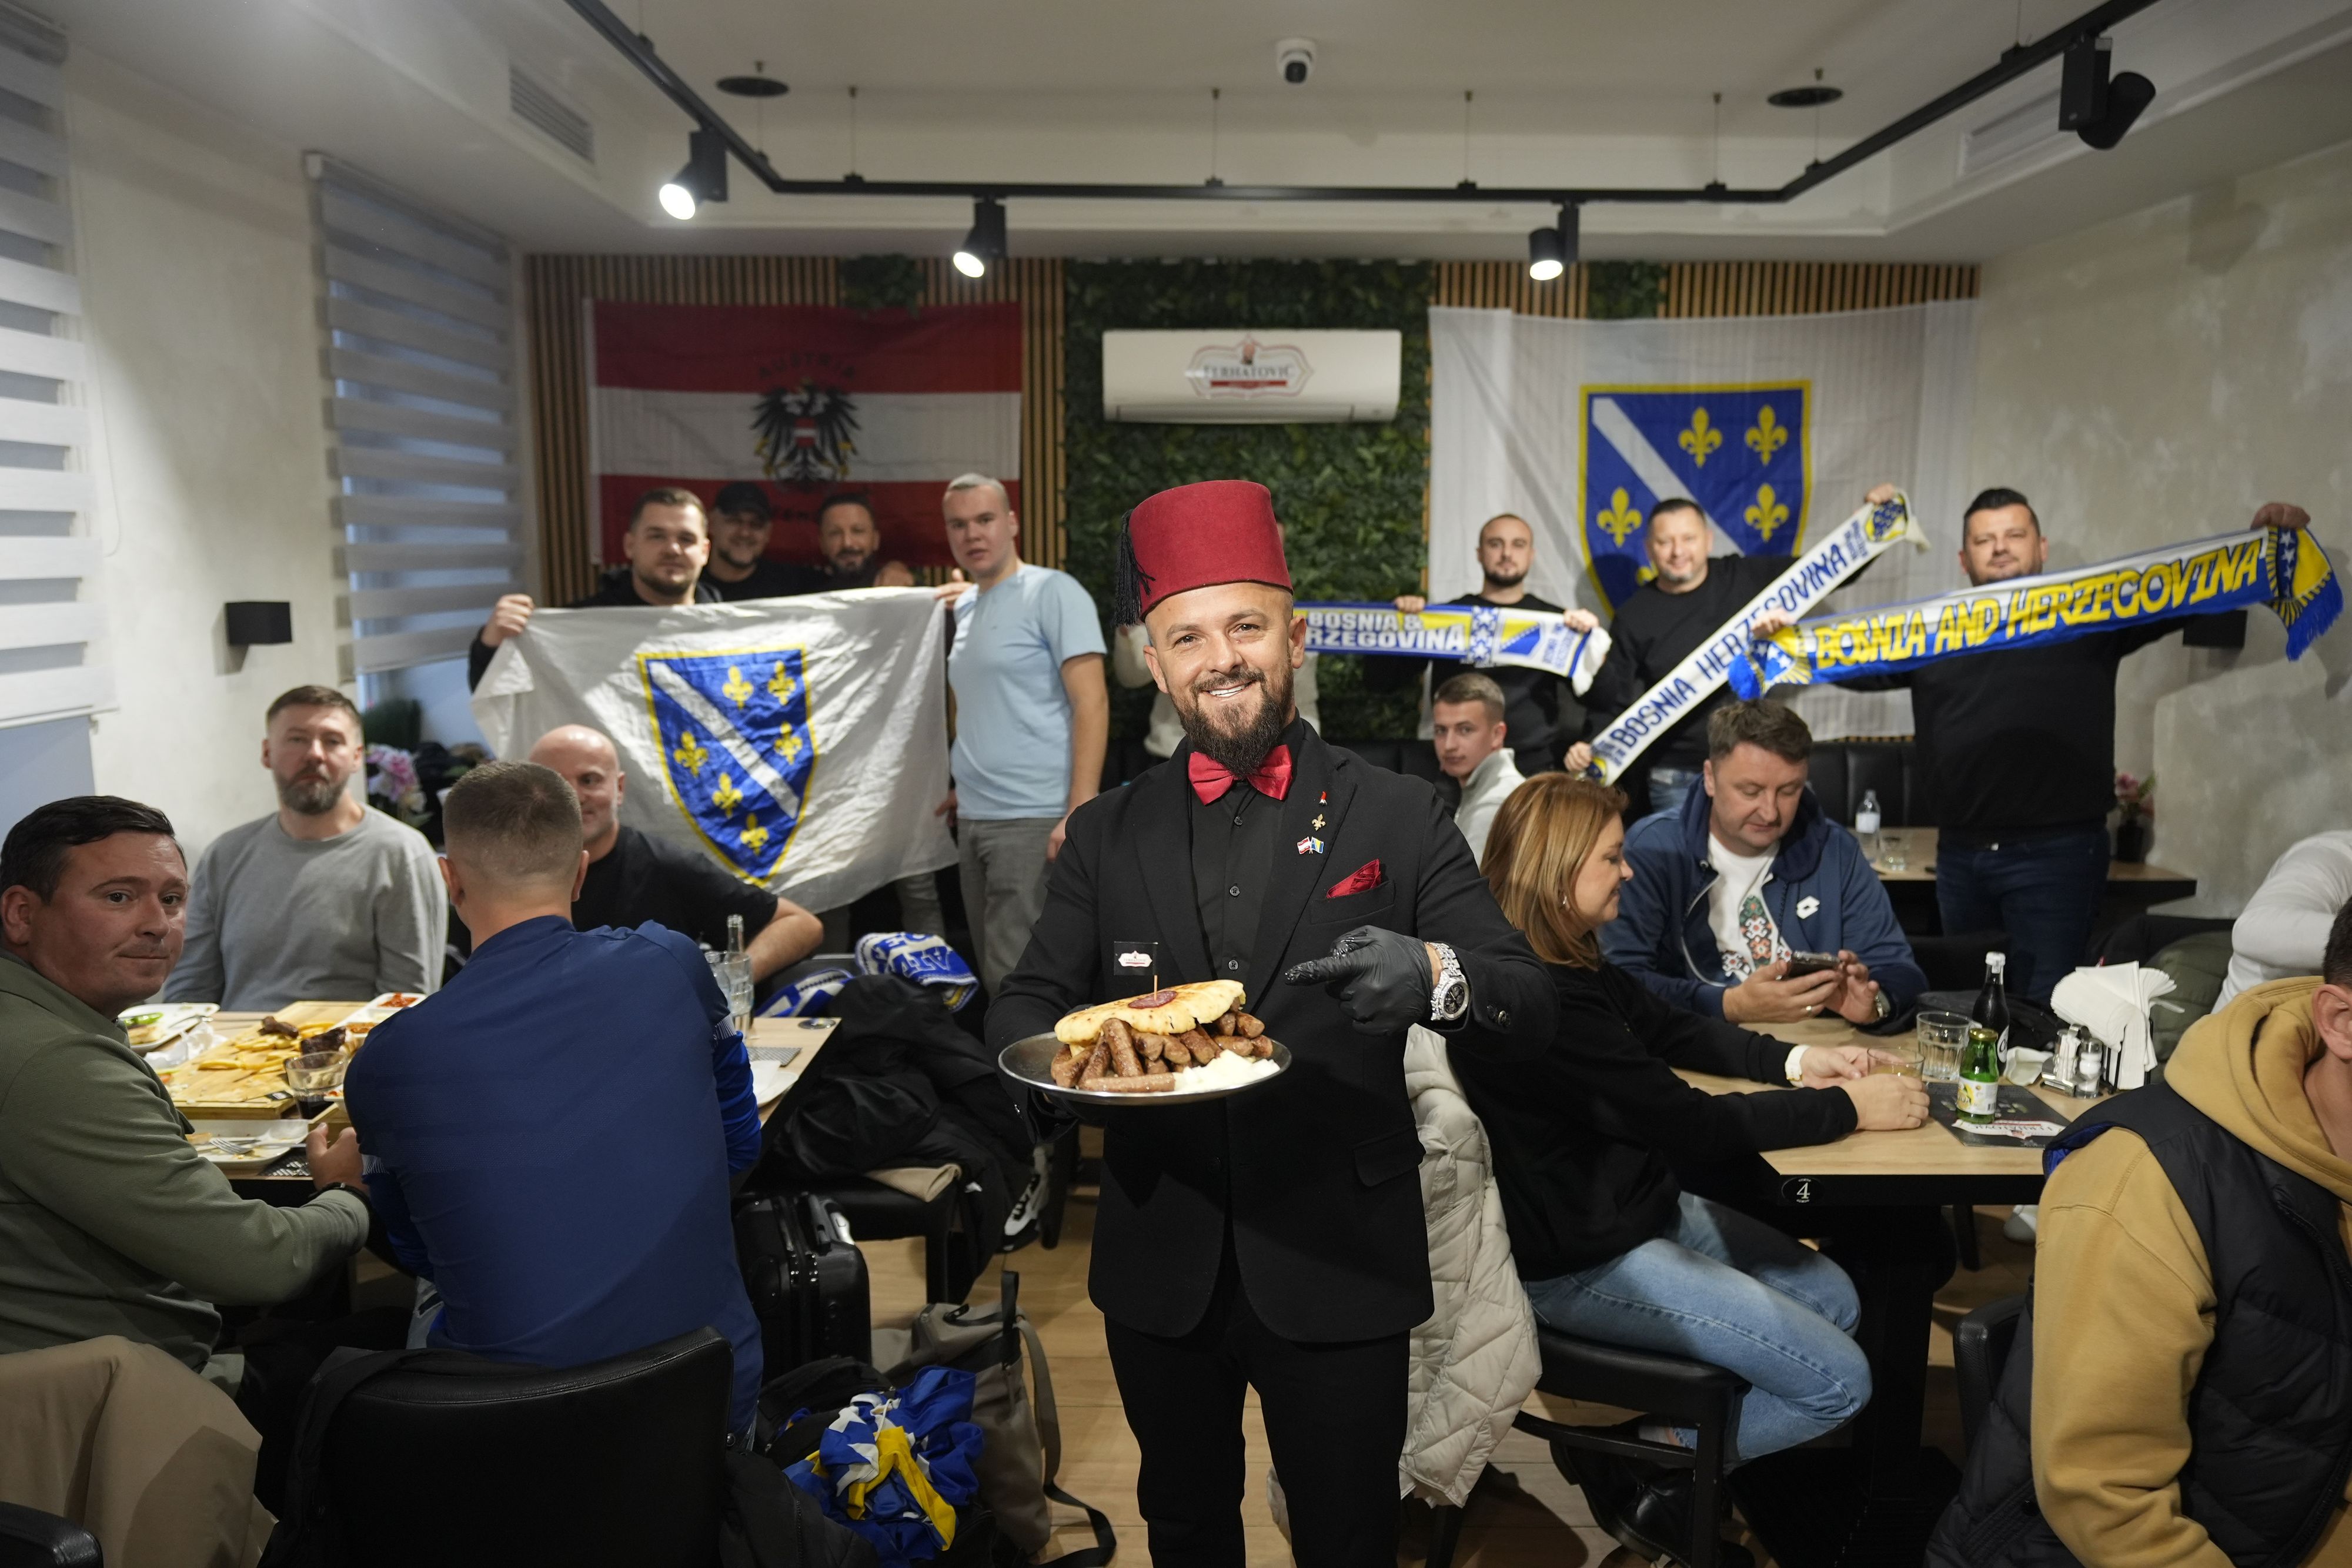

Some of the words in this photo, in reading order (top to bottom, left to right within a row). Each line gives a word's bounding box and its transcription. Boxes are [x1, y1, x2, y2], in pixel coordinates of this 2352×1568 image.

[1813, 609, 1926, 669] BOSNIA
[1933, 598, 2000, 655] AND
[2006, 537, 2263, 639] HERZEGOVINA
[1308, 611, 1399, 631] BOSNIA
[1404, 613, 1424, 631] &
[1305, 624, 1466, 651] RZEGOVINA
[1610, 677, 1697, 748] BOSNIA
[1797, 1182, 1810, 1199] 4
